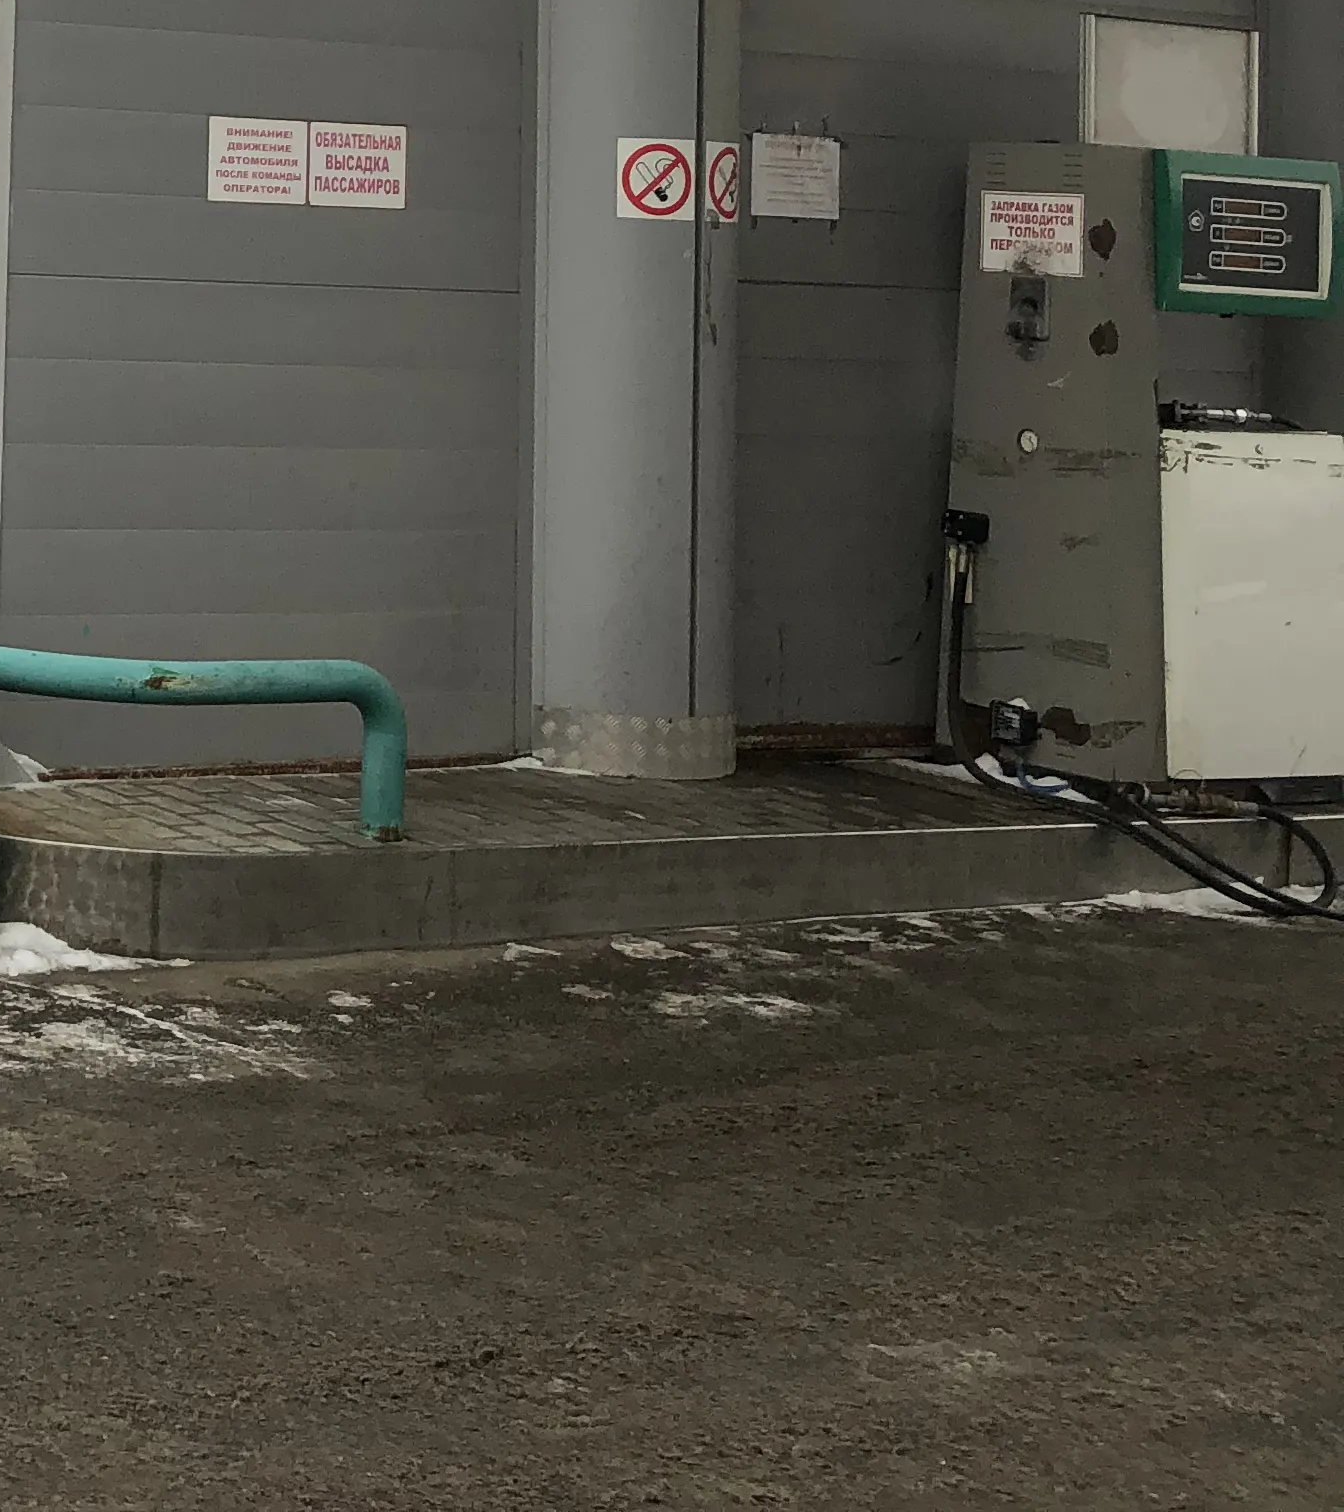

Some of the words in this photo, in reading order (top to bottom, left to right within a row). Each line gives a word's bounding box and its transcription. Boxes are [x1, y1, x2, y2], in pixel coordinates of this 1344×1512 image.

[226, 127, 293, 139] ВНИМАНИЕ!
[226, 141, 292, 153] ДВИЖЕНИЕ
[315, 131, 401, 151] ОБЯЗАТЕЛЬНАЯ
[219, 155, 299, 167] АВТОМОБИЛЯ
[325, 153, 390, 174] ВЫСАДКА
[215, 169, 249, 179] ПОСЛЕ
[251, 171, 302, 182] КОМАНДЫ
[223, 183, 291, 195] ОПЕРАТОРА!
[314, 175, 400, 195] ПАССАЖИРОВ
[990, 200, 1039, 213] ЗАПРАВКА
[1042, 203, 1074, 214] ГАЗОМ
[990, 213, 1074, 226] ПРОИЗВОДИТСЯ
[1007, 225, 1056, 239] ТОЛЬКО
